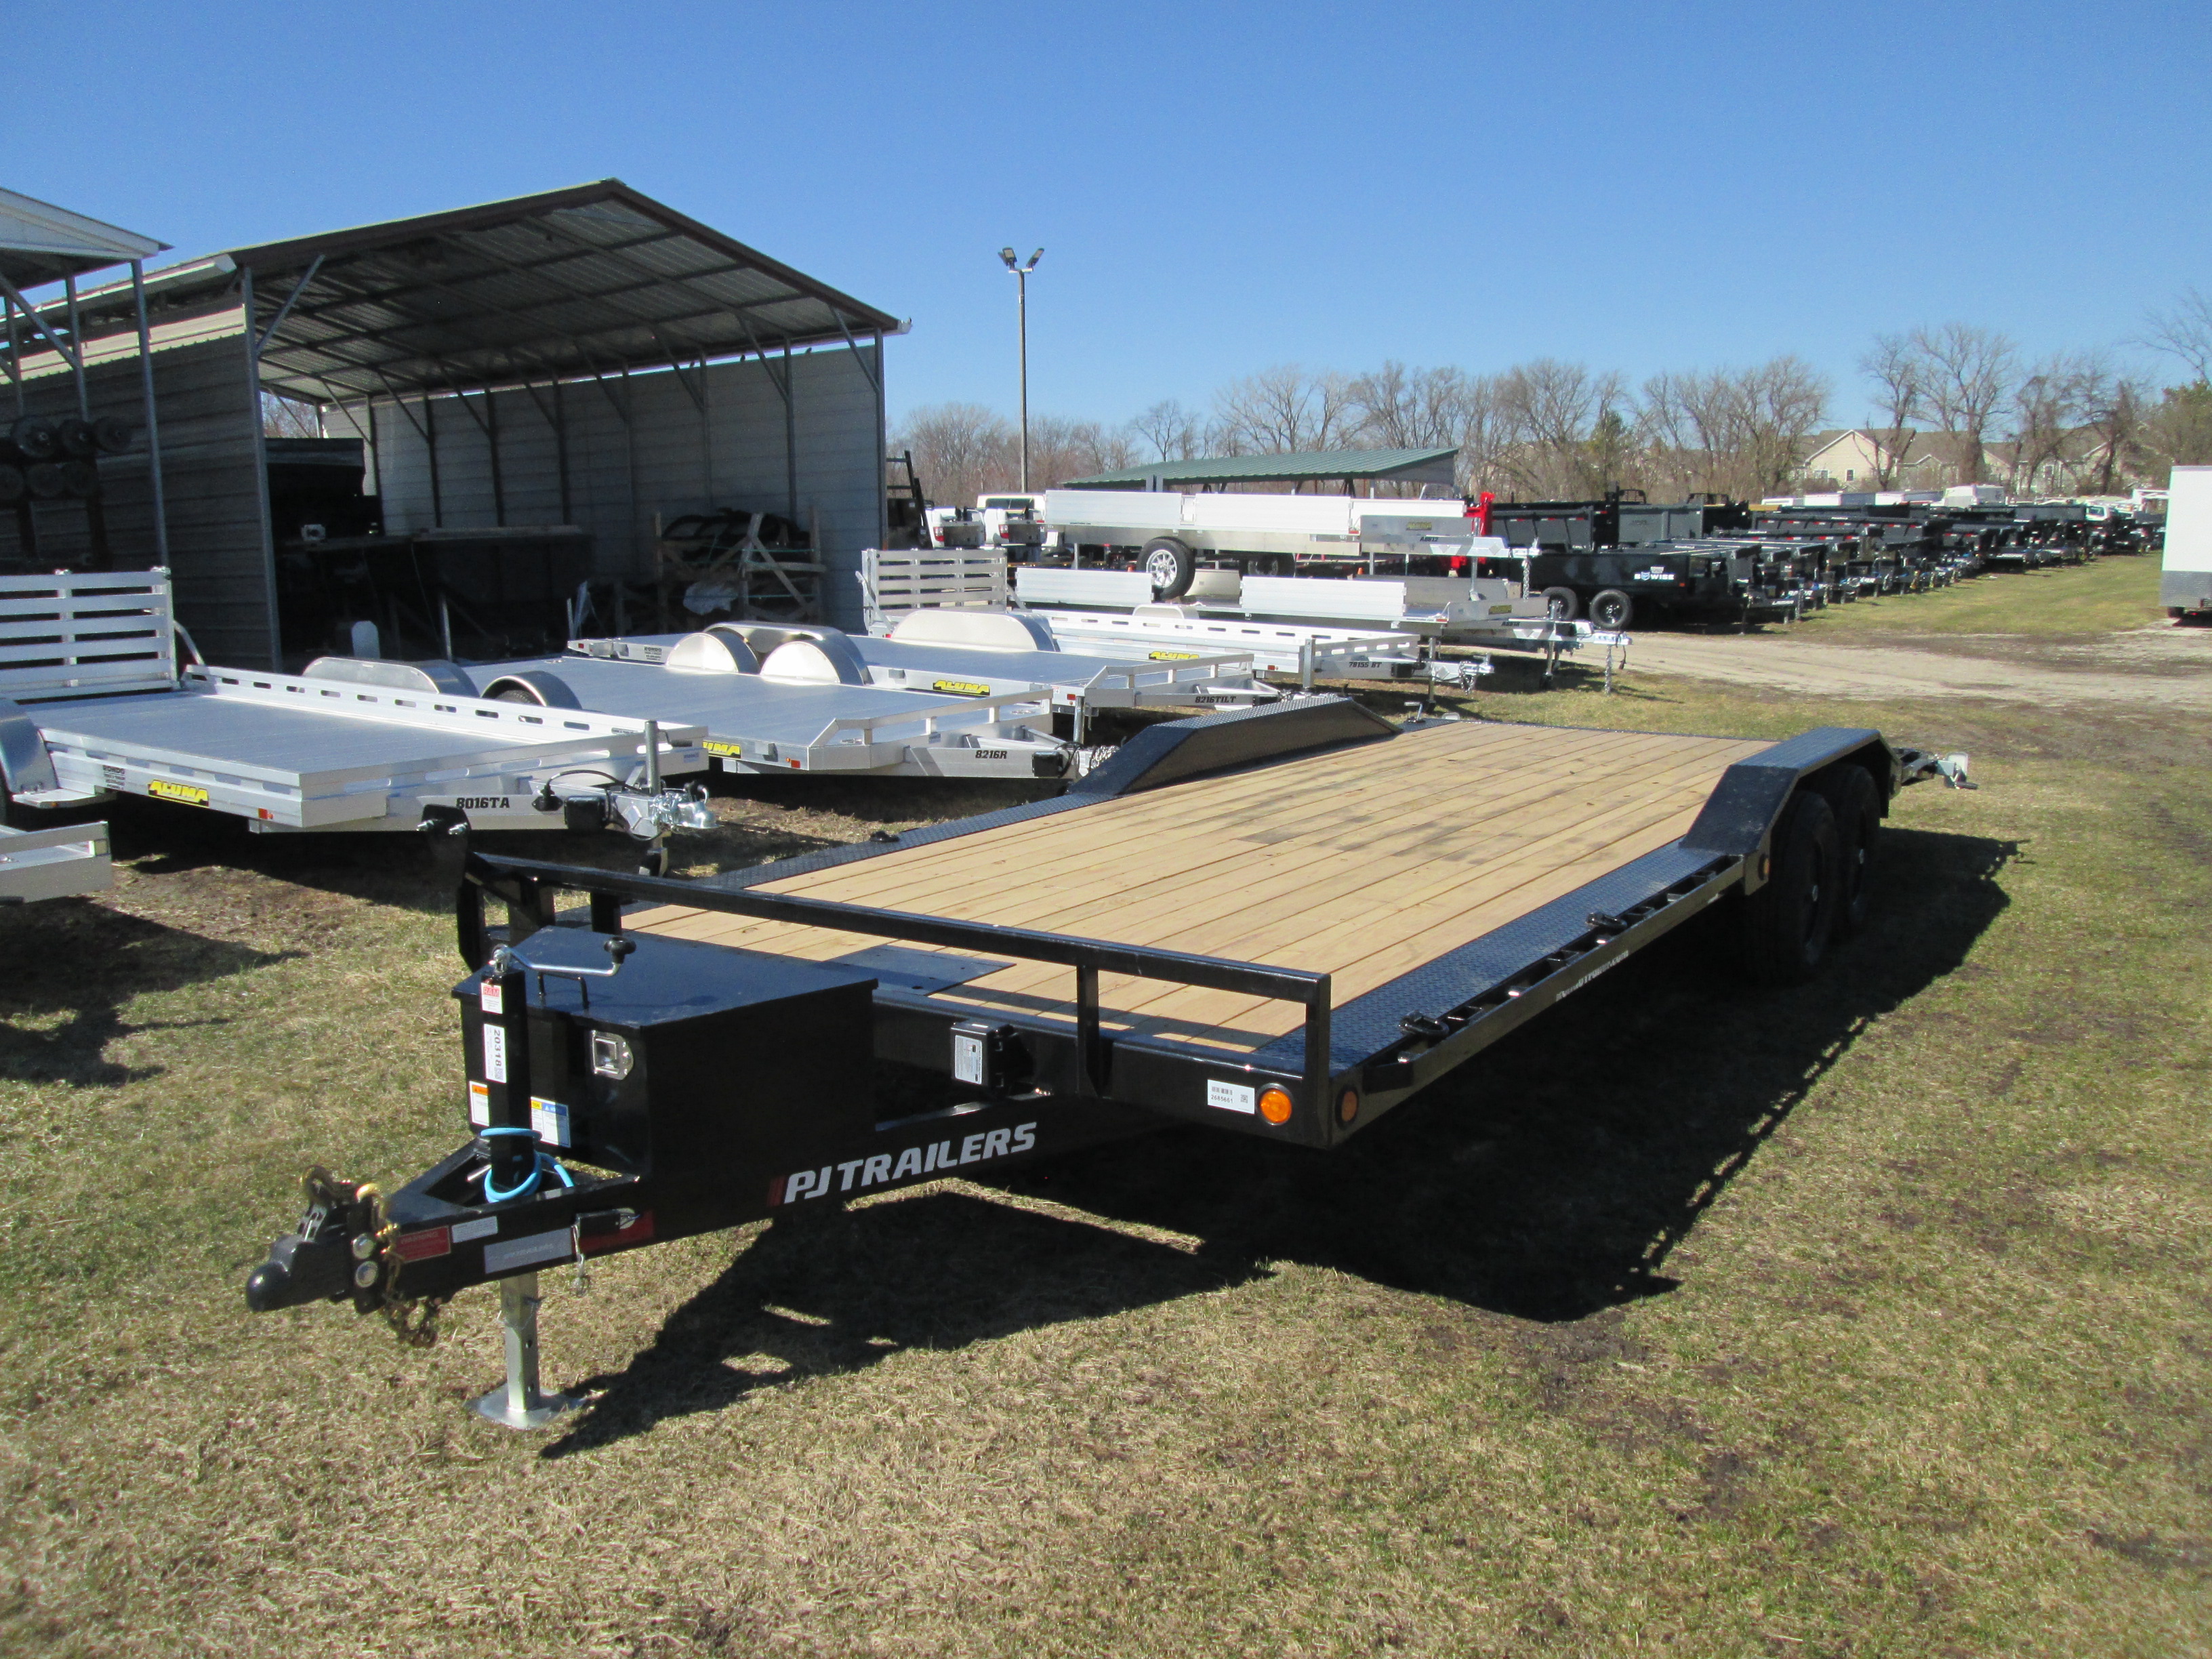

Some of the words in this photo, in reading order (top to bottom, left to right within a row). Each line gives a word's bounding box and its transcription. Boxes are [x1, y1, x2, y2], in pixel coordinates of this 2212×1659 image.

[935, 680, 989, 694] ALUMA
[702, 741, 741, 756] UMA
[975, 750, 1008, 759] 8216R
[148, 779, 209, 803] ALUMA
[456, 797, 510, 809] 8016TA
[484, 986, 500, 998] RAM
[493, 1029, 503, 1067] 20318
[783, 1166, 832, 1204] PJ
[837, 1122, 1038, 1192] TRAILERS
